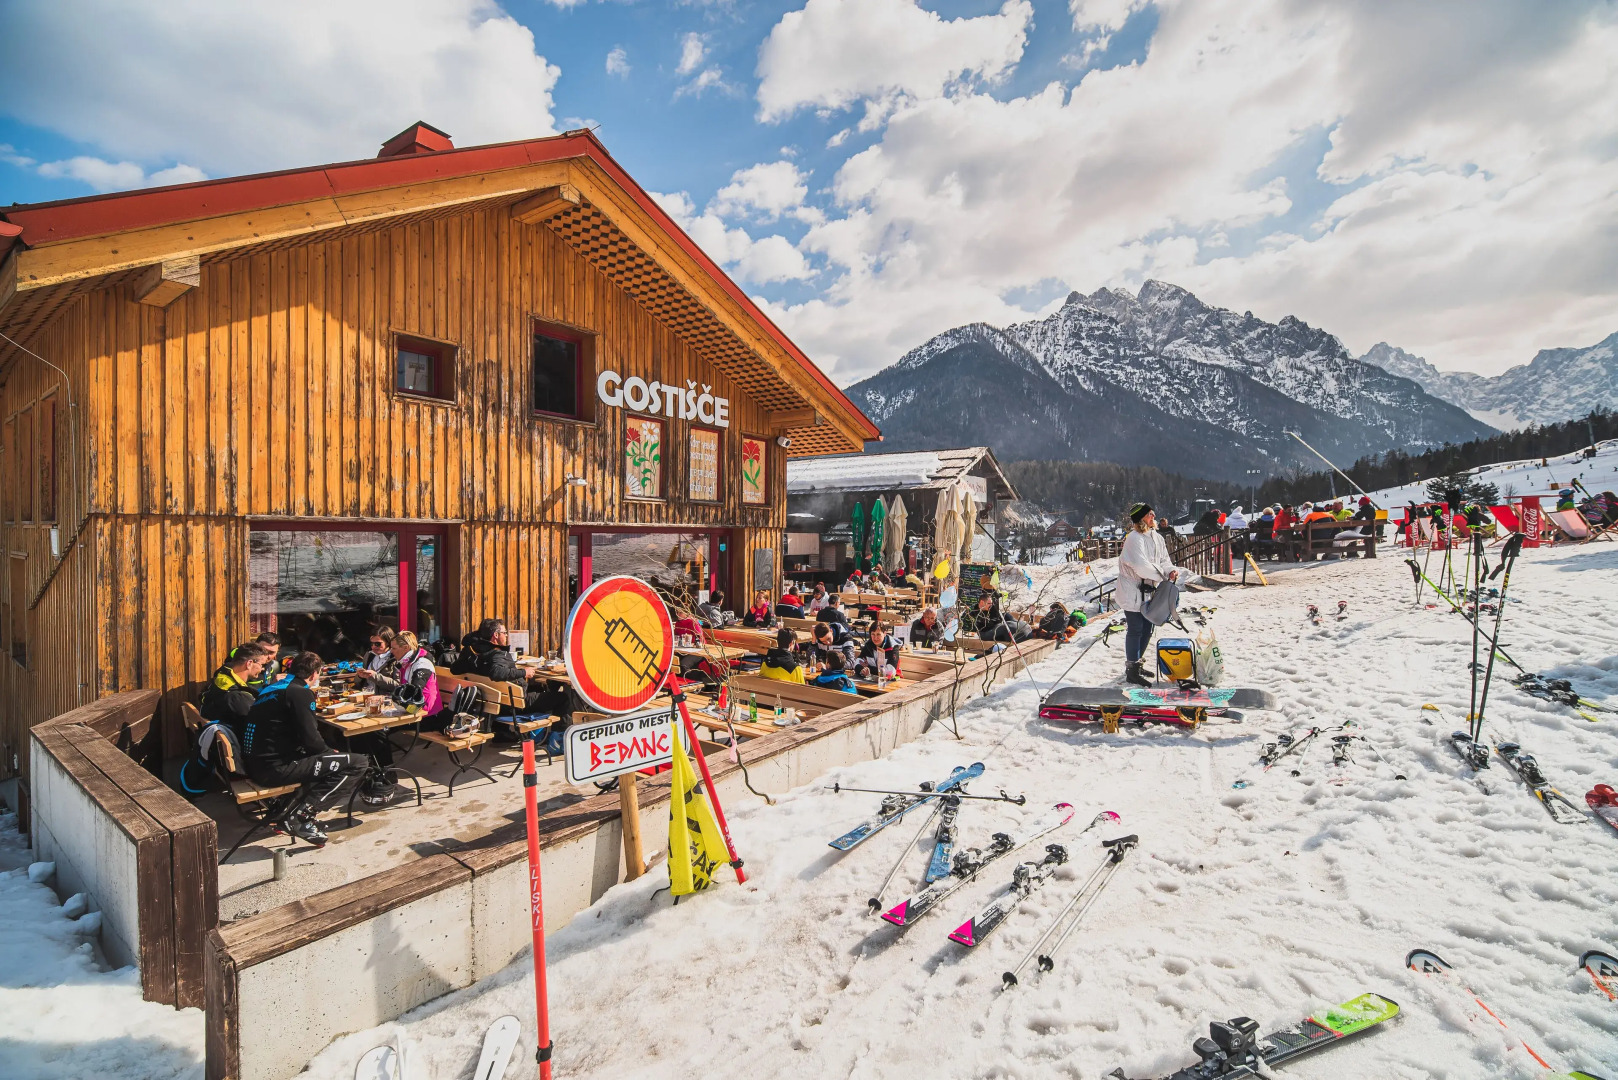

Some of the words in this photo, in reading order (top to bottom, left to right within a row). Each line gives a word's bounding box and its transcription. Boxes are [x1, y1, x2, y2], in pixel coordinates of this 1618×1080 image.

[597, 370, 729, 428] GOSTIŠČE
[579, 721, 634, 741] CEPILNO
[589, 731, 670, 772] BEDANC
[531, 869, 541, 927] LISKI
